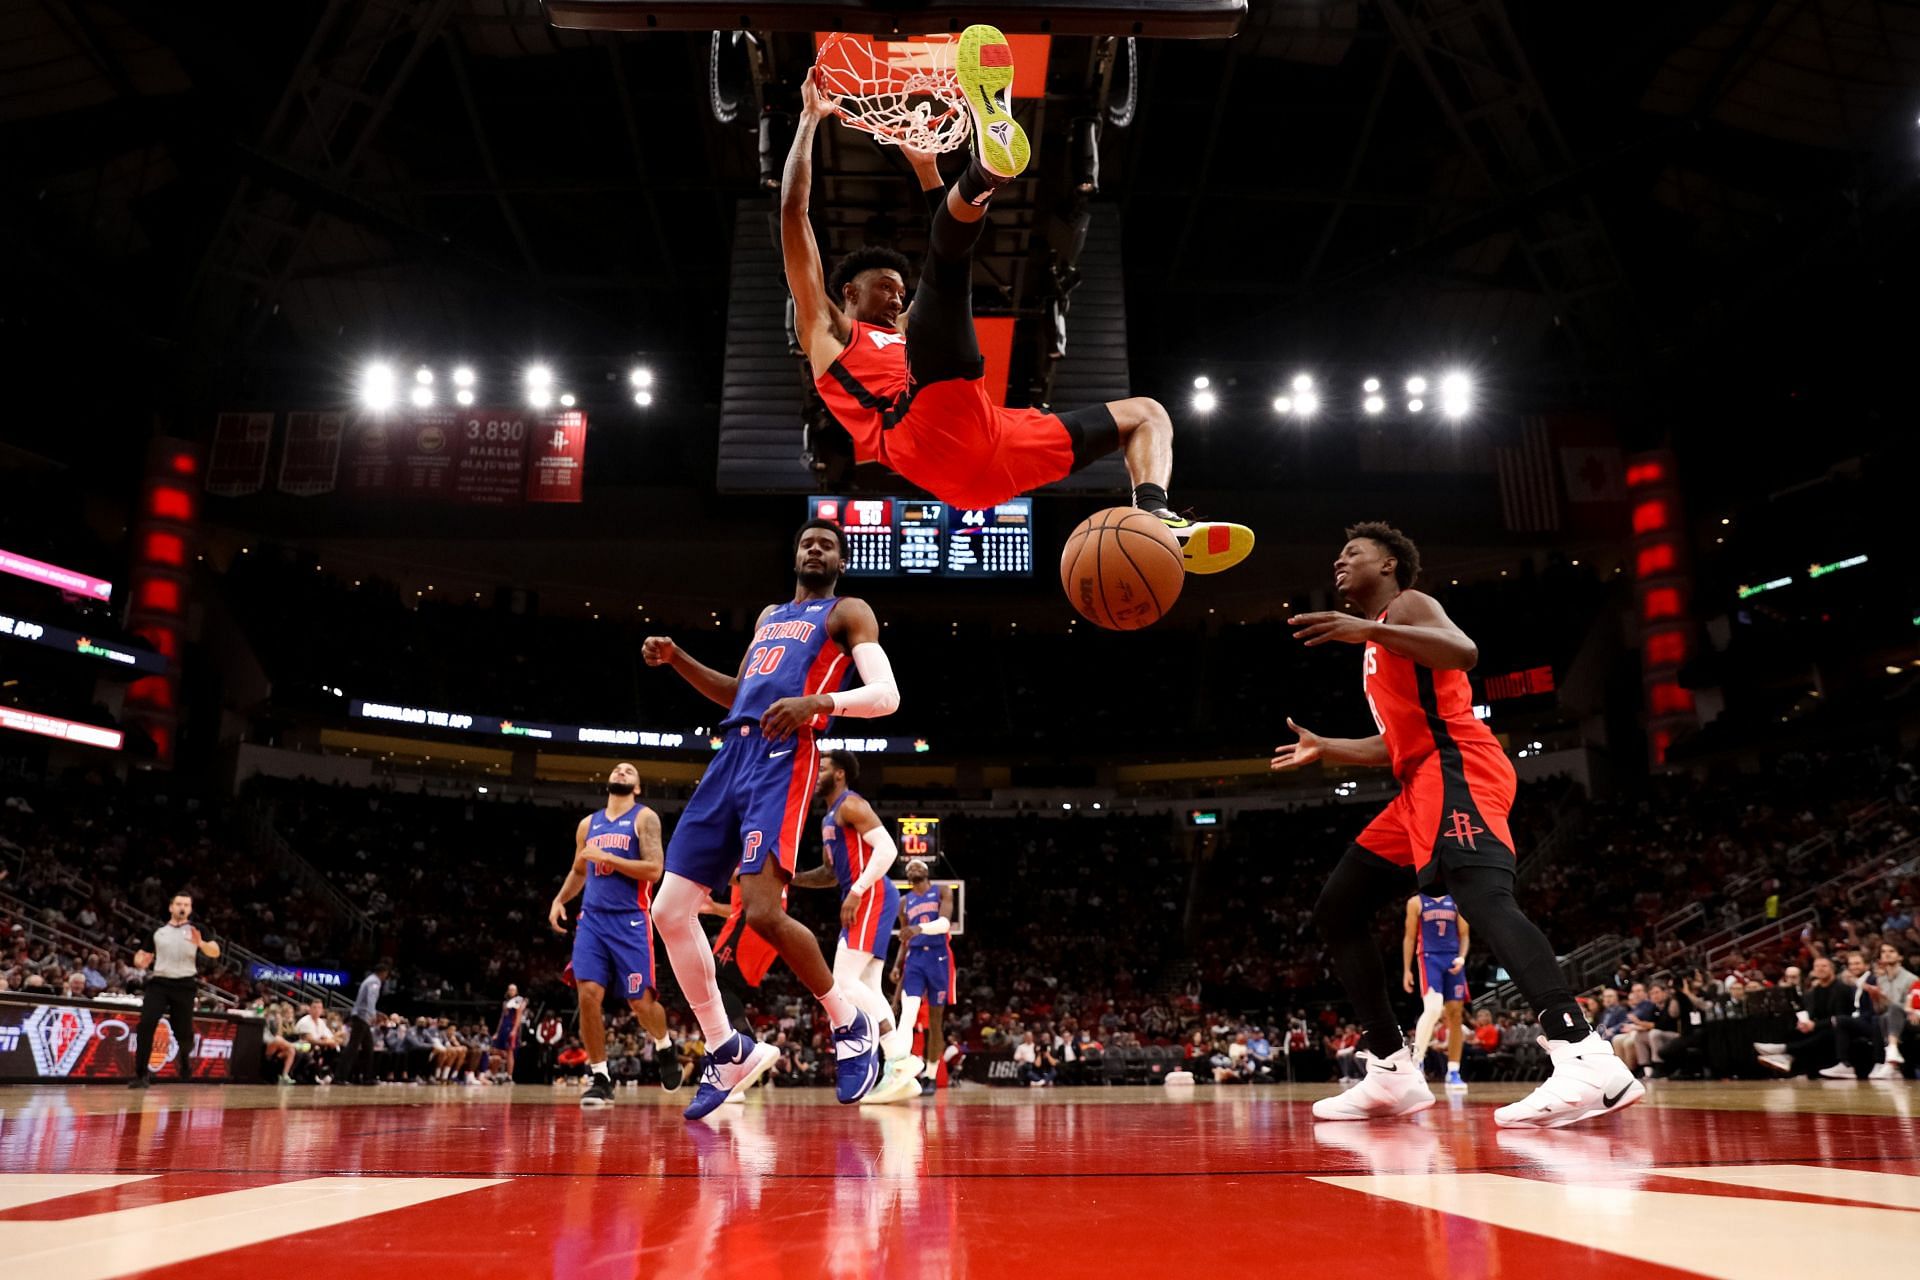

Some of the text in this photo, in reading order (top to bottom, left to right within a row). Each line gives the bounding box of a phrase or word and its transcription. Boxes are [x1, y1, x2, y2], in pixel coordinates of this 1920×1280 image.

[14, 620, 43, 640] APP
[744, 645, 786, 680] 20
[427, 711, 449, 726] THE
[449, 713, 472, 728] APP
[639, 733, 660, 745] THE
[660, 734, 683, 747] APP
[845, 738, 865, 751] THE
[866, 739, 887, 751] APP
[303, 972, 341, 986] ULTRA
[200, 1038, 233, 1059] ESPN
